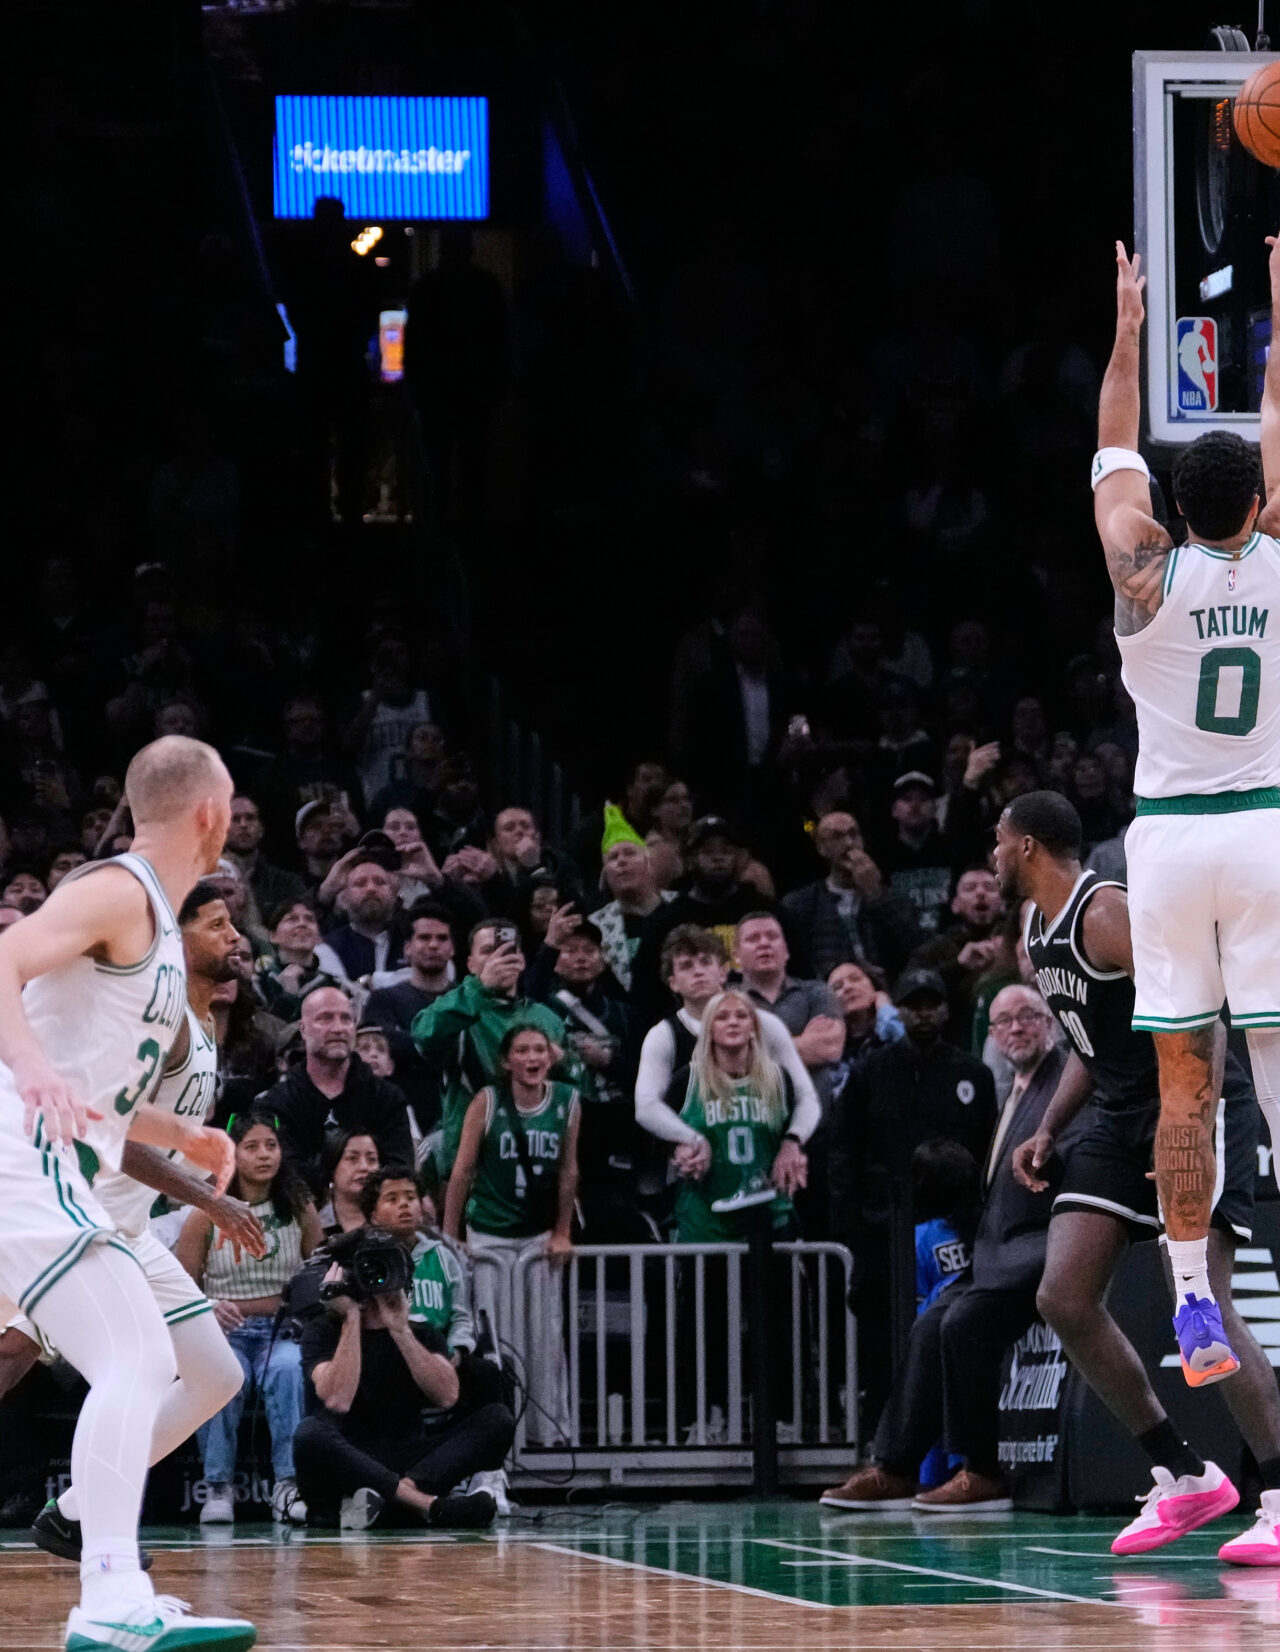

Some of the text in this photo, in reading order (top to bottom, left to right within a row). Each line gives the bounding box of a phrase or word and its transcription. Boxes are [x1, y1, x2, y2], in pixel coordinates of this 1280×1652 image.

[1182, 391, 1202, 406] NBA
[1189, 605, 1269, 640] TATUM
[1195, 646, 1261, 737] 0
[114, 1037, 168, 1122] 3
[727, 1126, 756, 1164] 0
